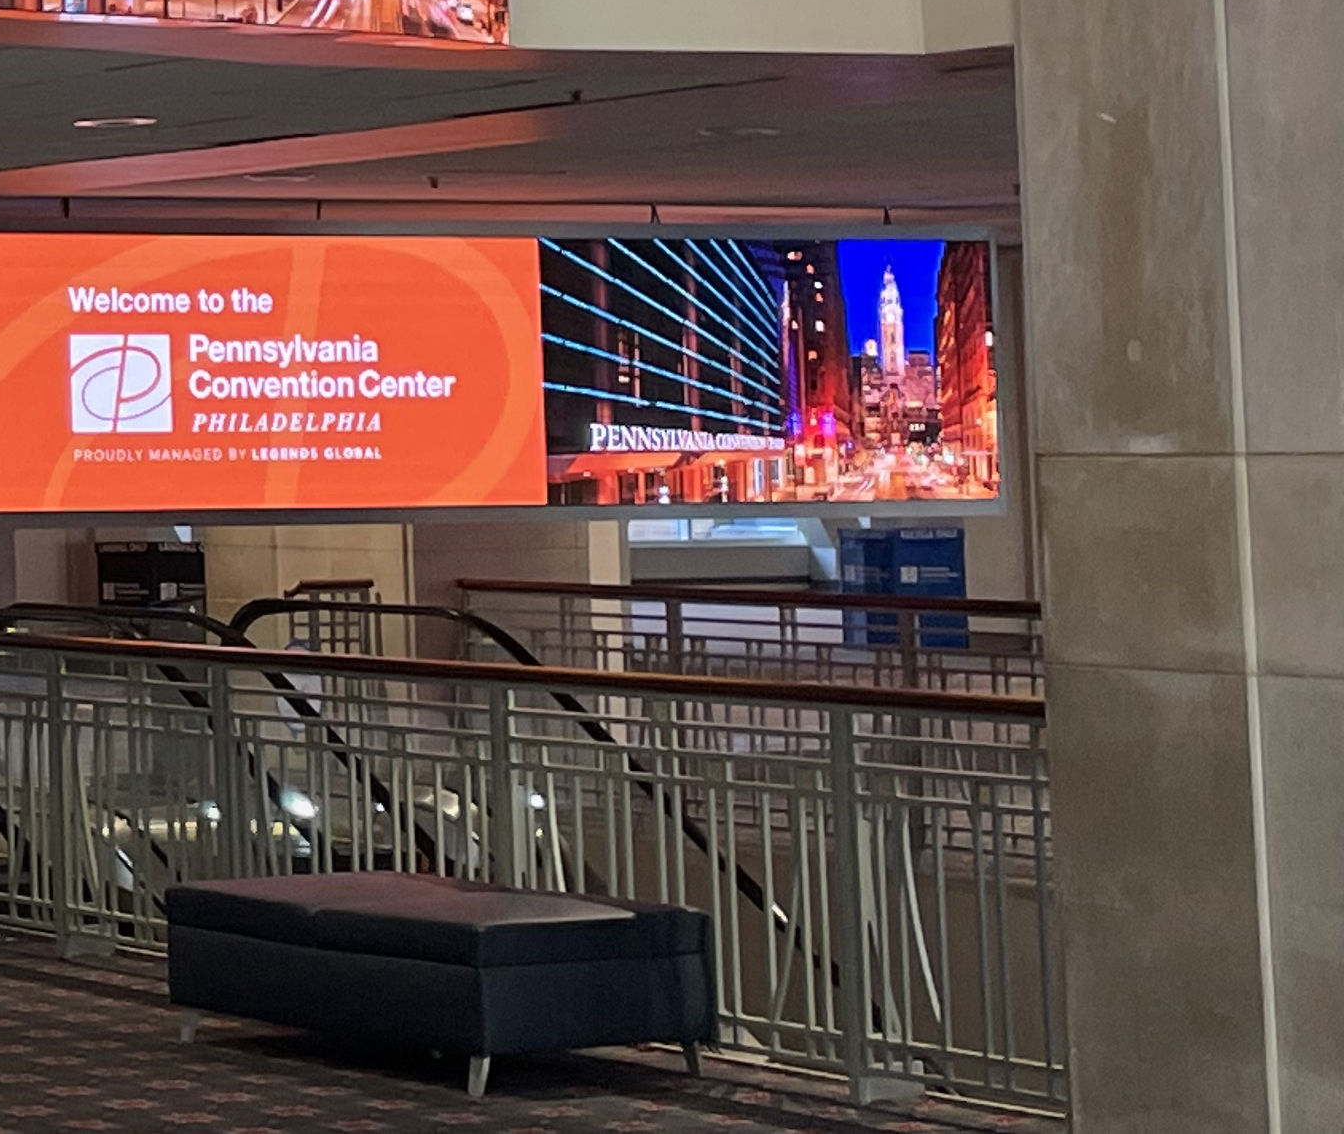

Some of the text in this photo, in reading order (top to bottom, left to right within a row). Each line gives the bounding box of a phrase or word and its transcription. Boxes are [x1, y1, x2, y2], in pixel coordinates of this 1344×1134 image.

[67, 286, 274, 314] Welcome to the
[188, 333, 379, 369] Pennsylvania
[188, 369, 457, 400] Convention Center
[191, 411, 382, 433] PHILADELPHIA
[590, 423, 715, 452] PENNSYLVANIA
[73, 448, 143, 462] PROUDLY
[148, 447, 223, 462] MANAGED
[250, 446, 319, 461] LEGENDS
[323, 446, 382, 461] GLOBAL
